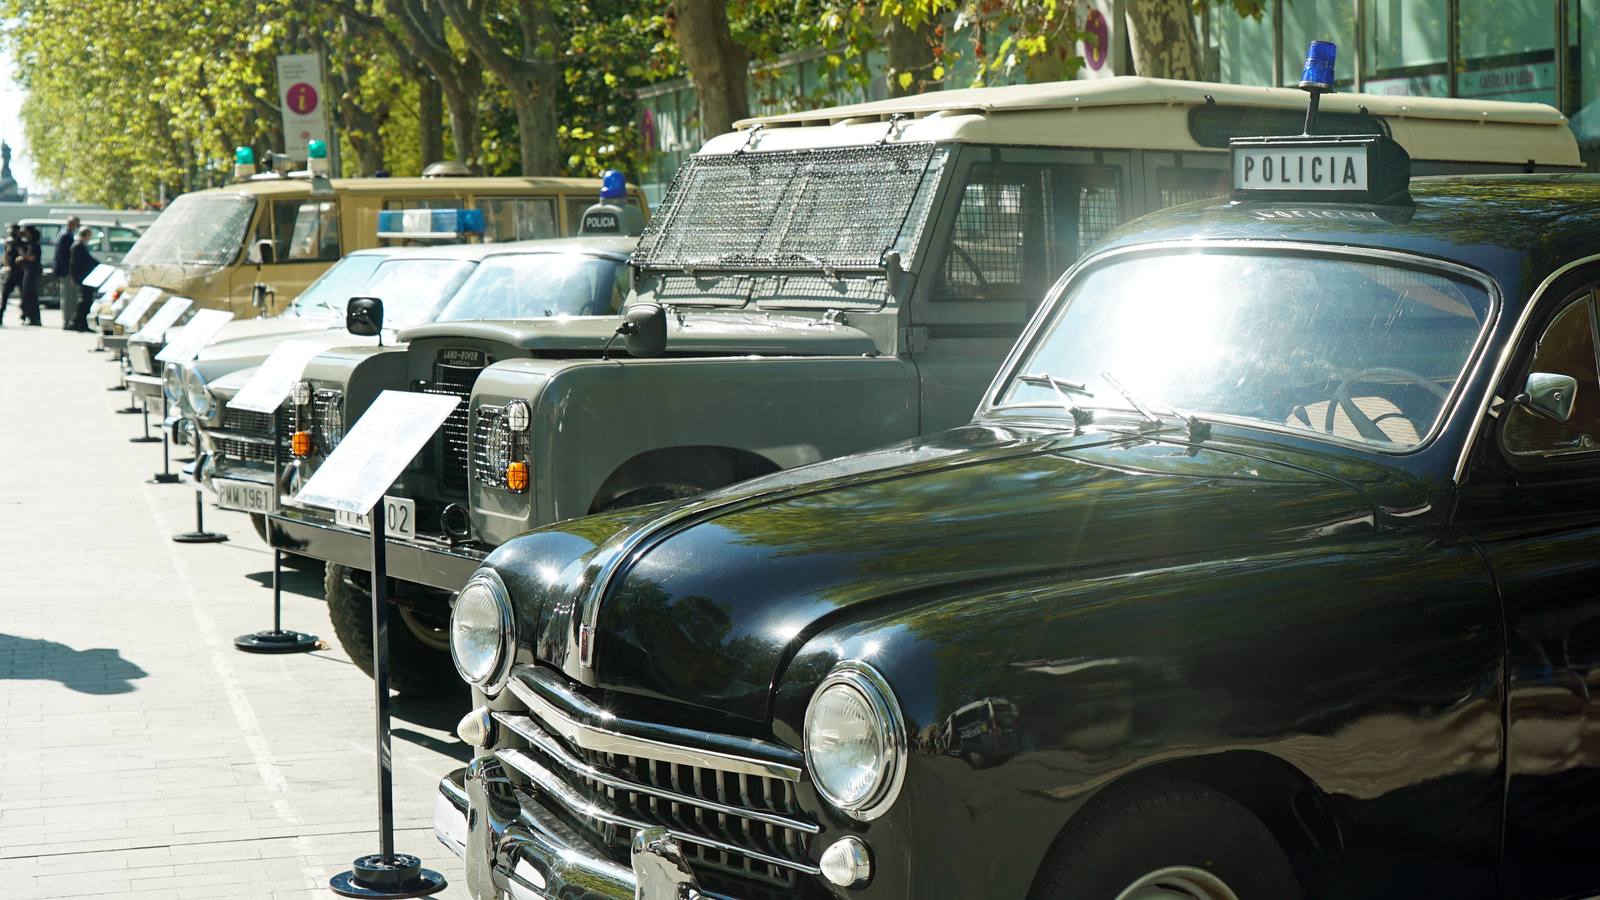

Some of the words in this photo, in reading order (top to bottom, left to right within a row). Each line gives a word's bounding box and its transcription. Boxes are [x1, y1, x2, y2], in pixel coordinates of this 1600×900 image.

[1244, 156, 1357, 184] POLICIA
[586, 216, 616, 228] POLICIA
[243, 487, 268, 511] 1961
